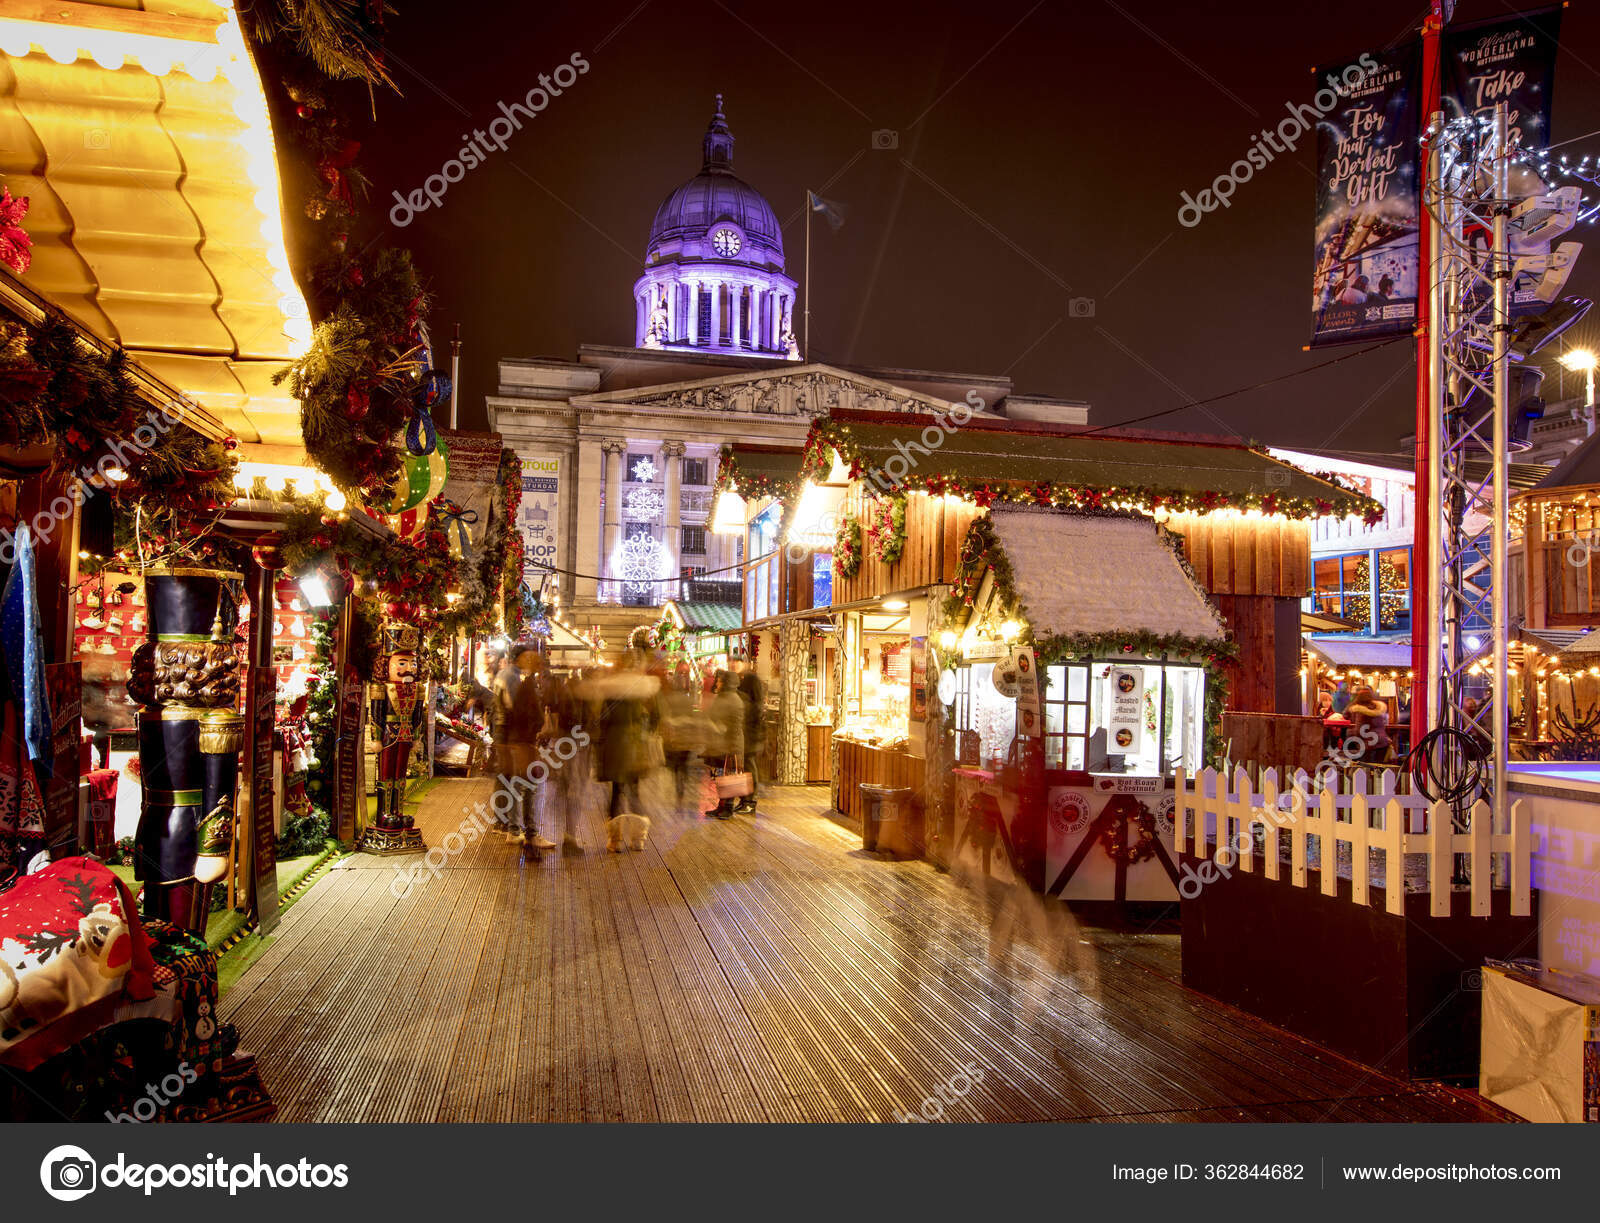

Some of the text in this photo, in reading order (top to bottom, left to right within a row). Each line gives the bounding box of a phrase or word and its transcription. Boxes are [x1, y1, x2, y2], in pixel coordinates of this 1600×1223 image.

[1461, 36, 1536, 63] WONDERLAND
[1336, 70, 1402, 96] WONDERLAND
[1468, 69, 1527, 108] Take
[1344, 104, 1386, 139] For
[1329, 141, 1404, 190] Perfect
[524, 545, 556, 557] HOP
[1115, 696, 1138, 704] Toasted
[1117, 778, 1157, 786] Hot Roast
